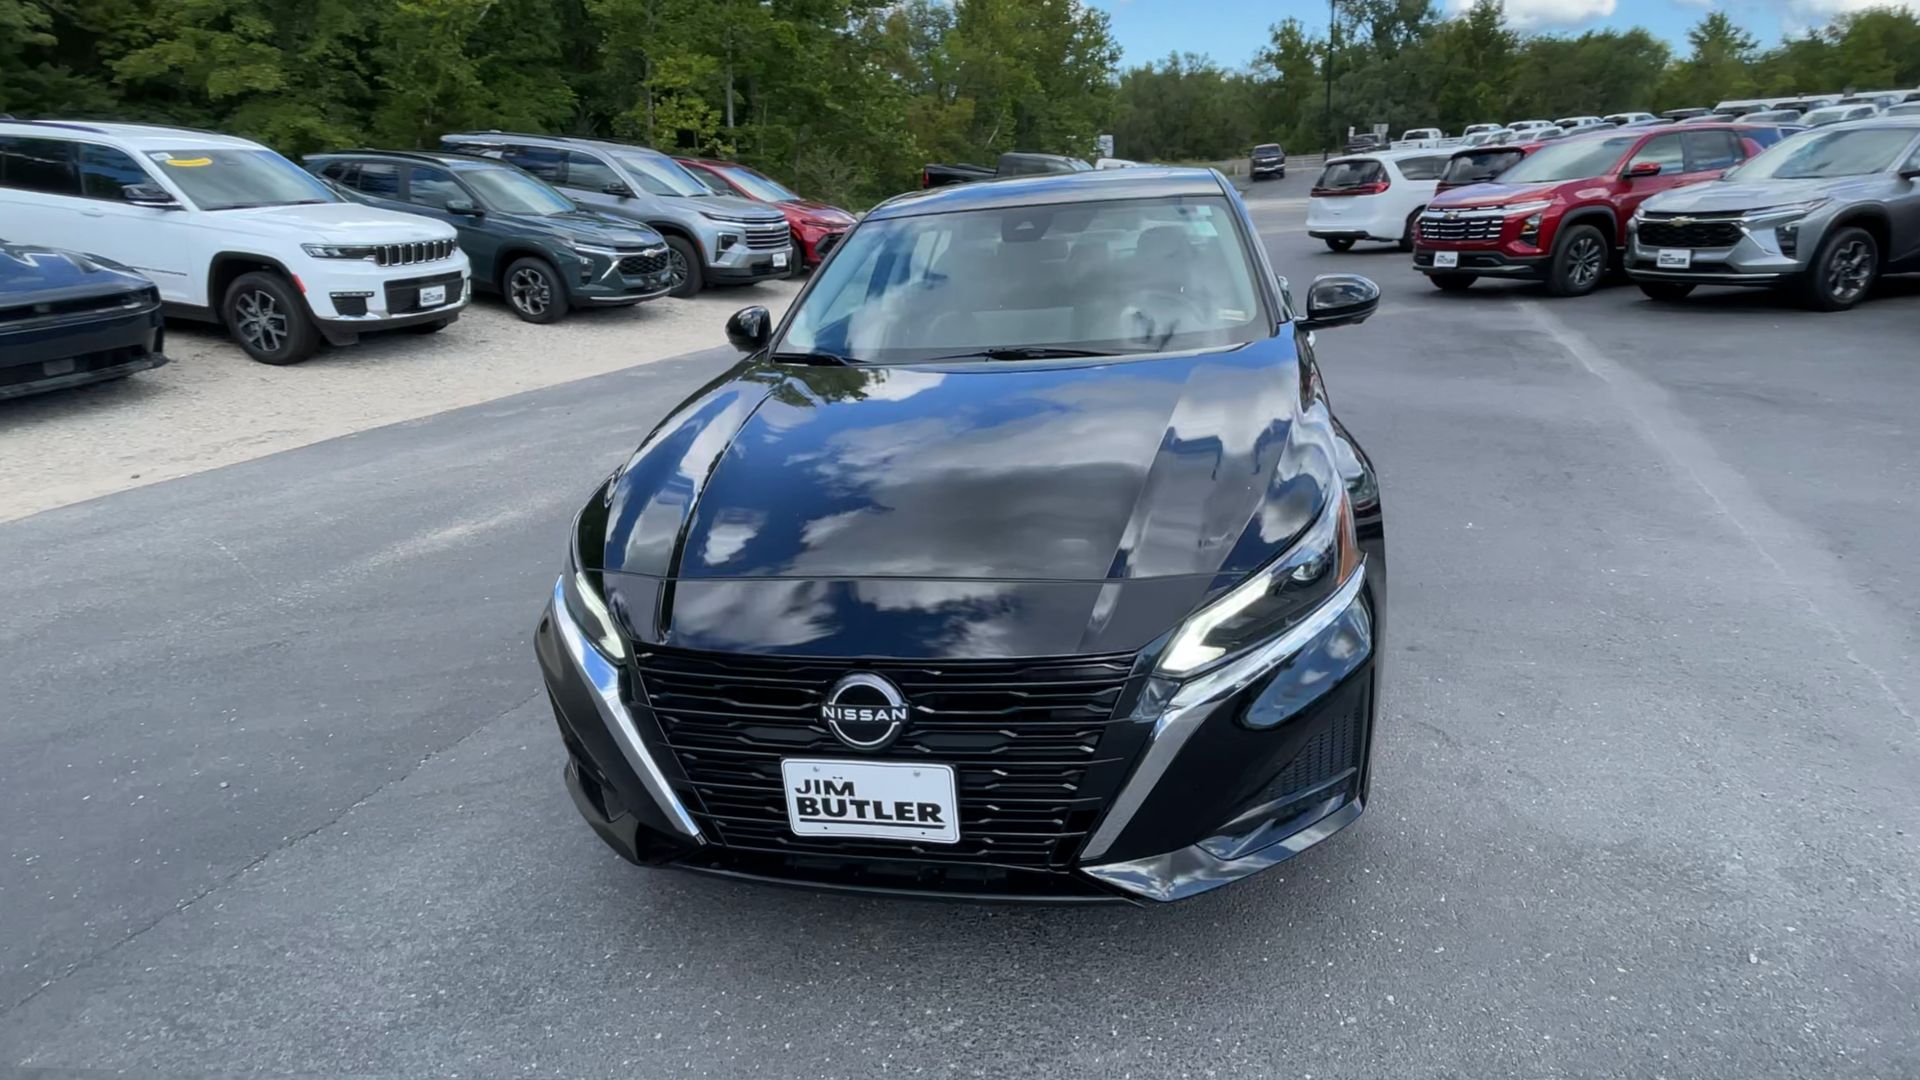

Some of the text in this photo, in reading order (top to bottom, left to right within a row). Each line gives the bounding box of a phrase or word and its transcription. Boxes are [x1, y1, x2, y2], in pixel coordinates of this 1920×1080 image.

[822, 705, 907, 721] NISSAN
[795, 779, 855, 797] JIM
[796, 797, 945, 823] BUTLER
